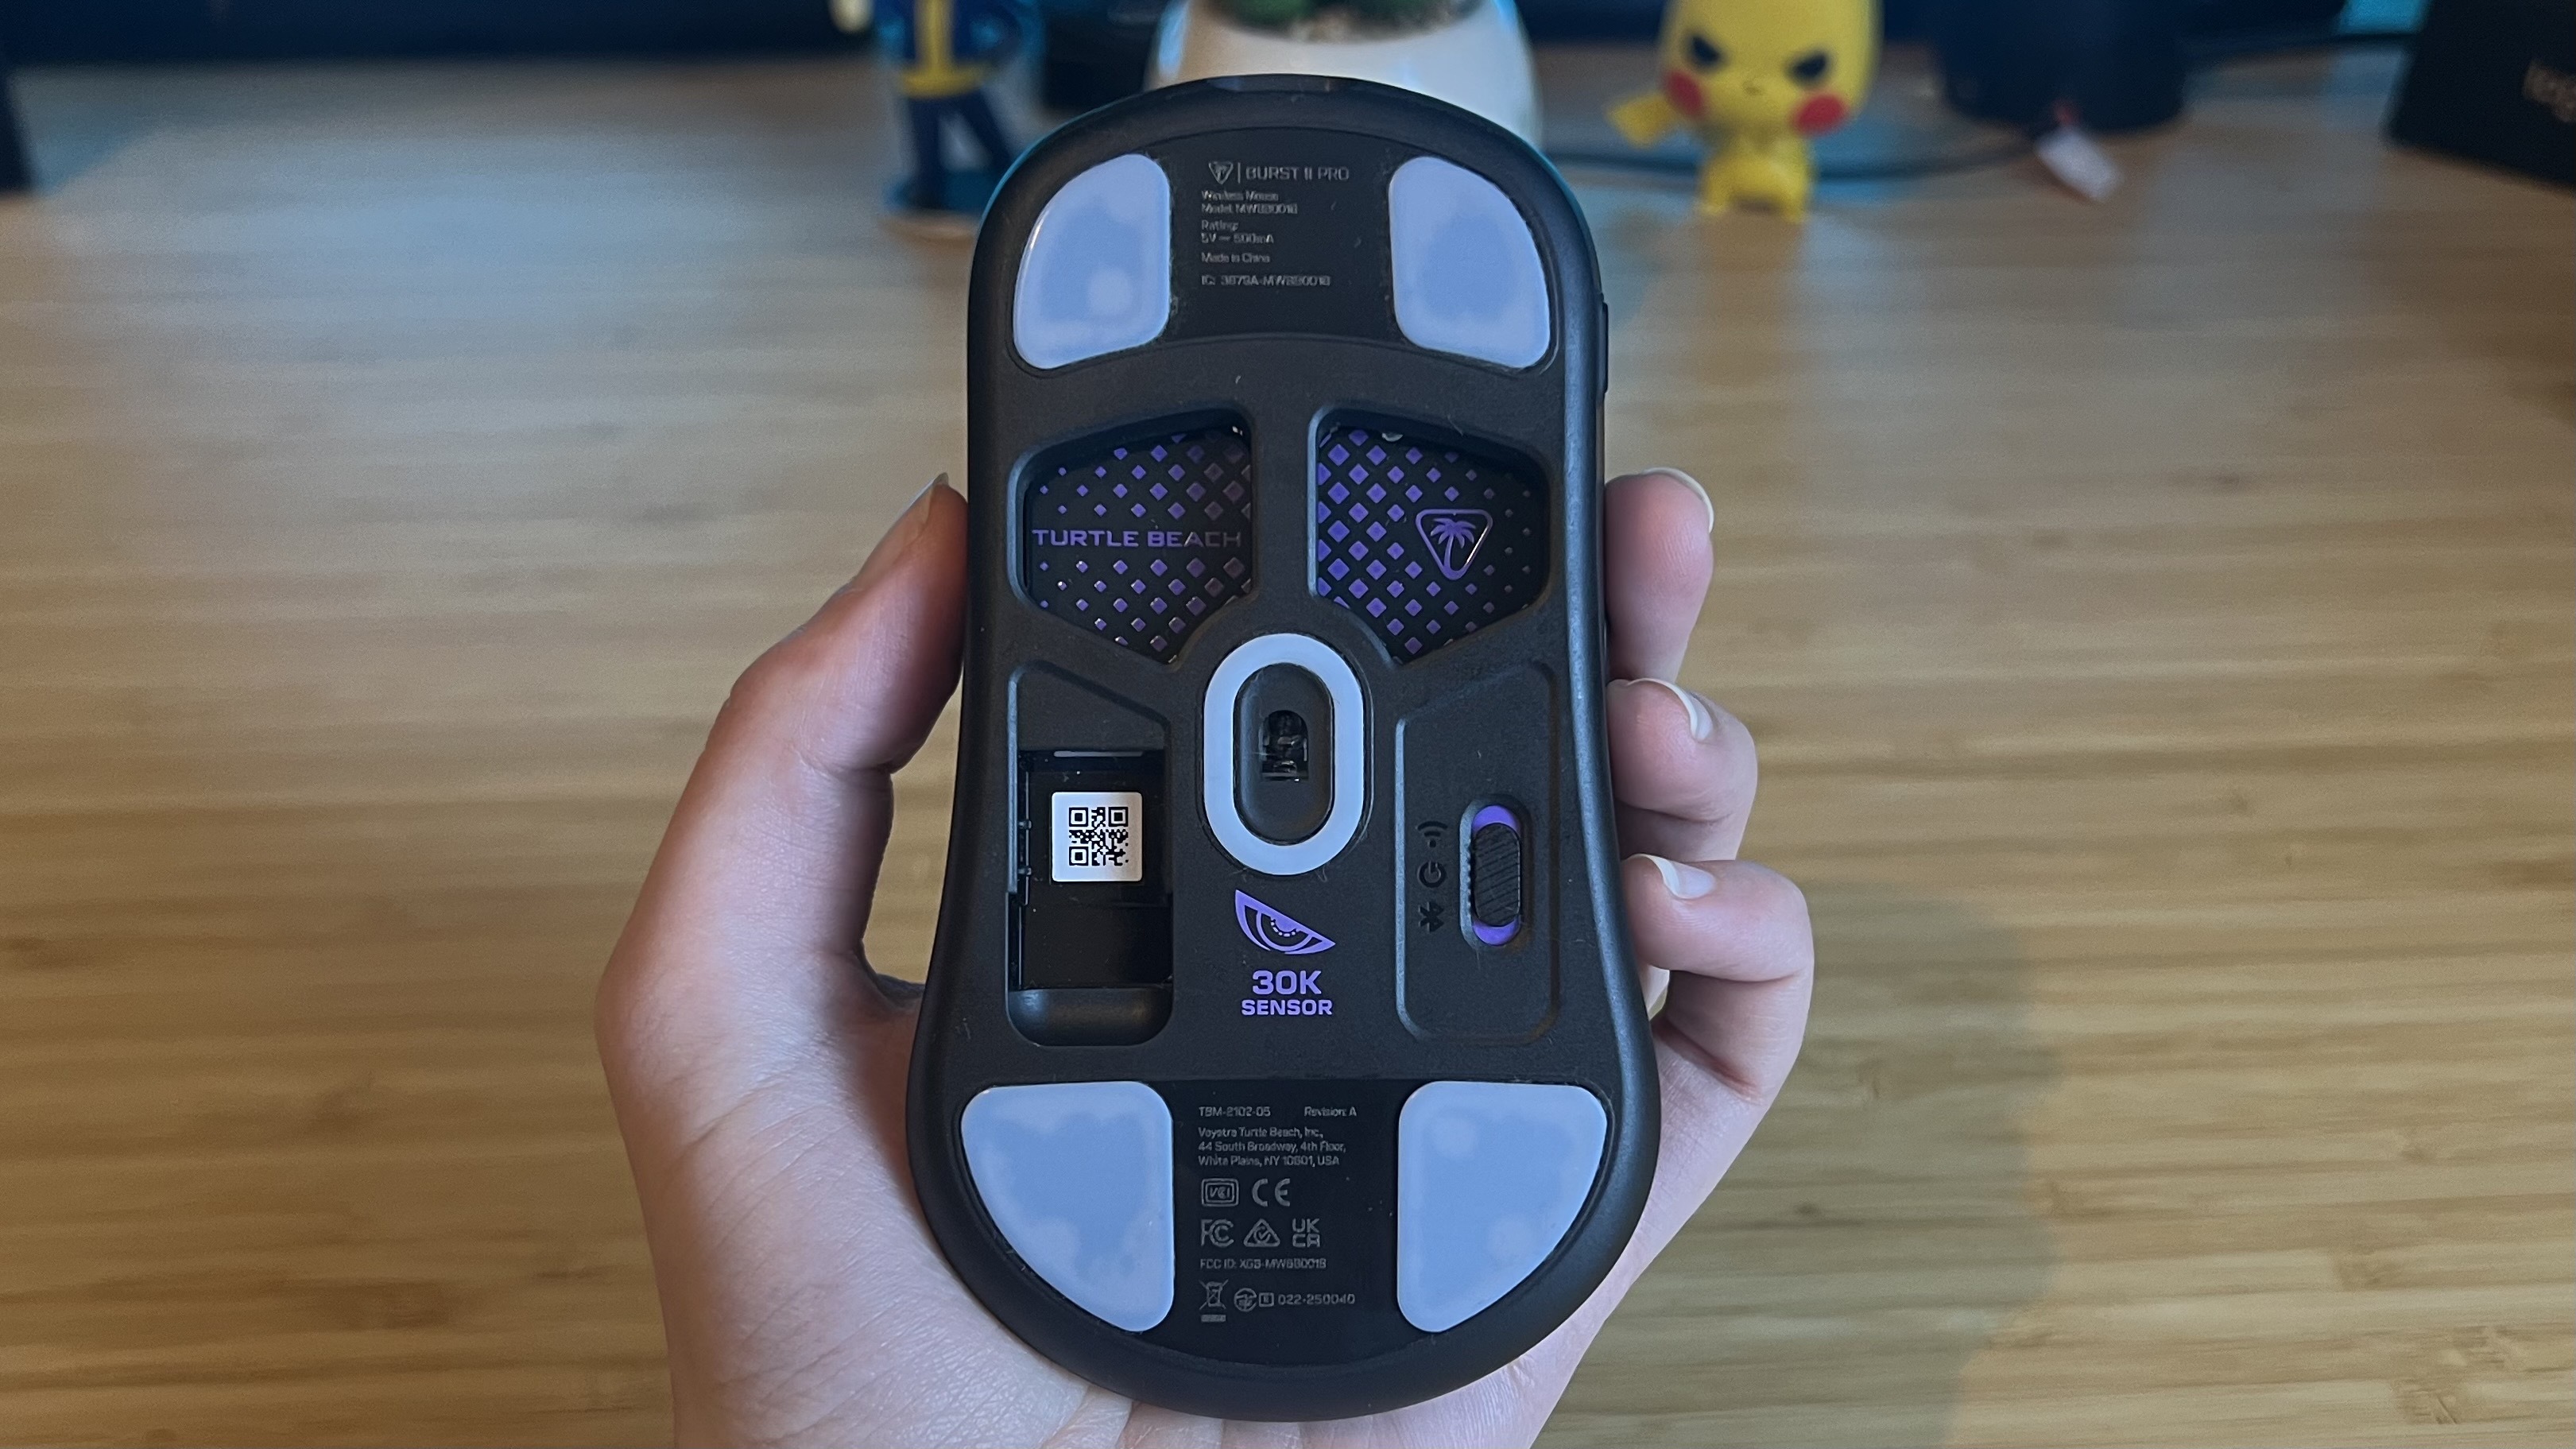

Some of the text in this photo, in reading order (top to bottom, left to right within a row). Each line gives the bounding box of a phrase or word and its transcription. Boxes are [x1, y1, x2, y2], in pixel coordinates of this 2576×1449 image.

[1245, 167, 1350, 180] BURST II PRO
[1245, 191, 1279, 201] Mouse
[1201, 233, 1217, 243] 5V
[1201, 252, 1270, 263] Made in China
[1032, 529, 1242, 548] TURTLE BEACH
[1253, 971, 1322, 994] 30K
[1242, 999, 1333, 1016] SENSOR
[1349, 1106, 1357, 1117] A
[1198, 1127, 1238, 1139] Voyetra
[1238, 1126, 1268, 1137] Turtle
[1270, 1127, 1303, 1139] Beach,
[1198, 1141, 1346, 1153] 44 South Broadway, 4th Floor,
[1198, 1154, 1229, 1166] White
[1230, 1155, 1262, 1168] Plains,
[1265, 1156, 1280, 1166] NY
[1318, 1155, 1339, 1166] USA
[1252, 1178, 1291, 1207] CE
[1200, 1258, 1222, 1269] FCC
